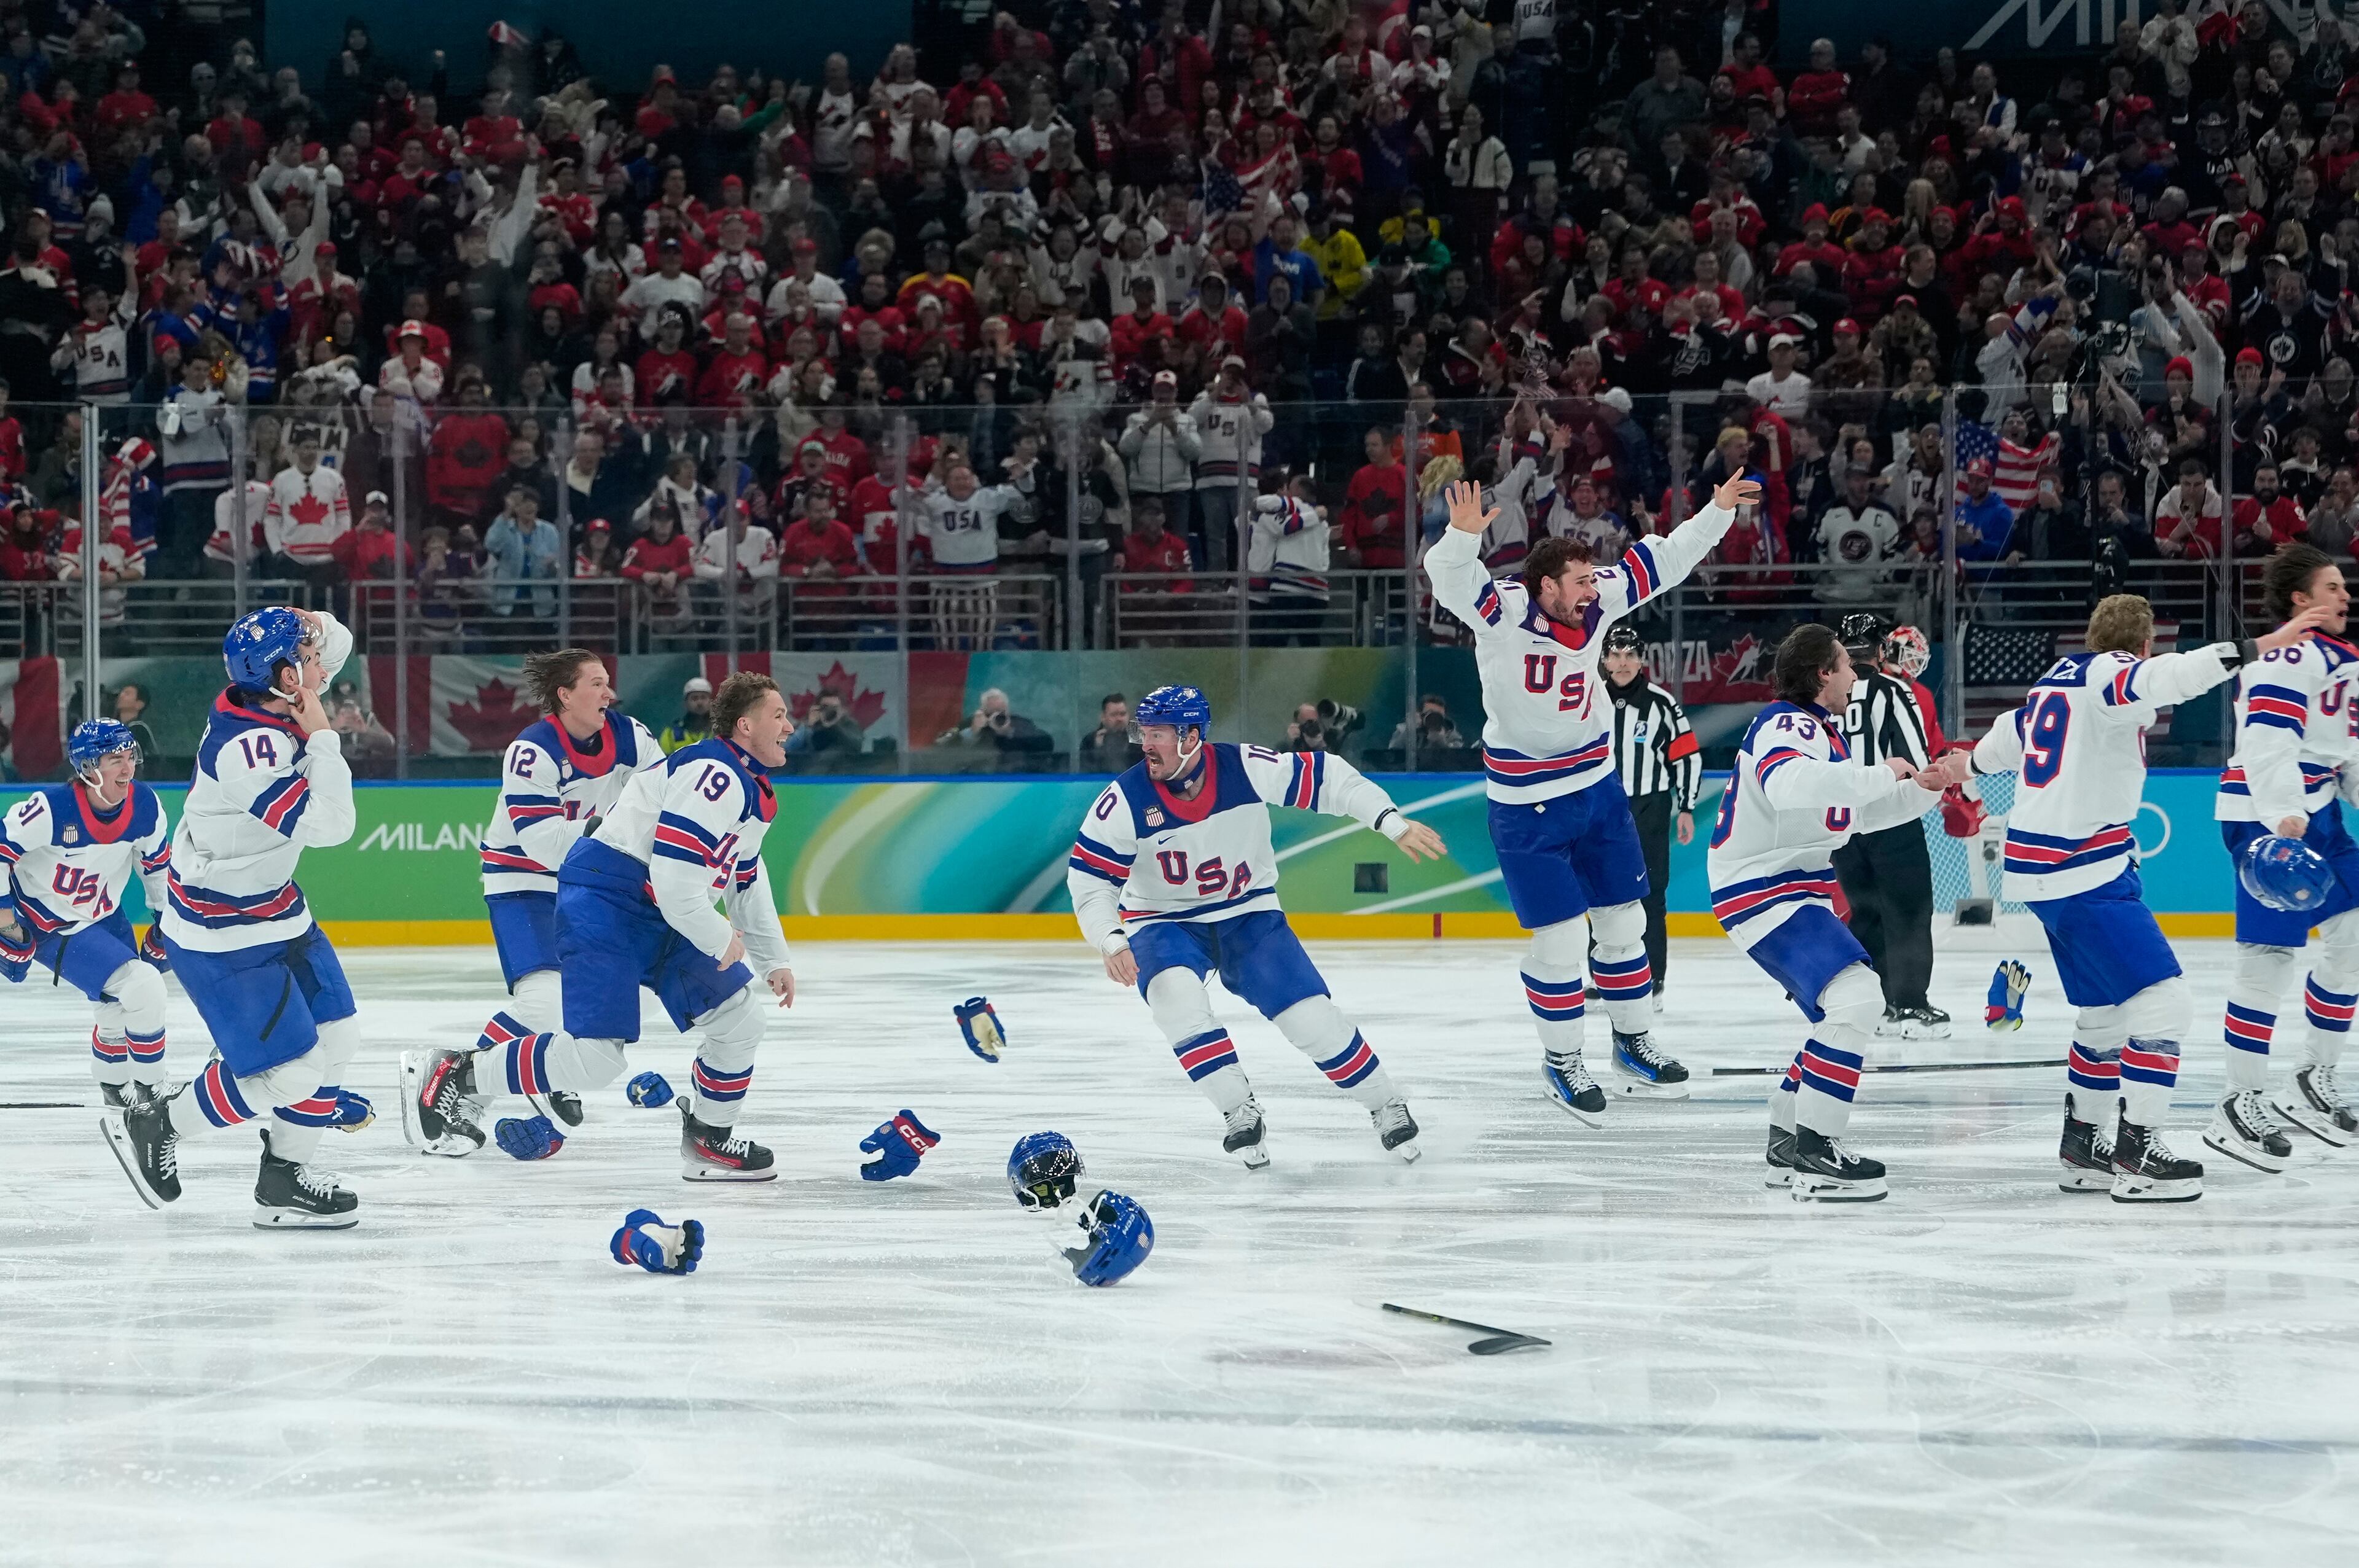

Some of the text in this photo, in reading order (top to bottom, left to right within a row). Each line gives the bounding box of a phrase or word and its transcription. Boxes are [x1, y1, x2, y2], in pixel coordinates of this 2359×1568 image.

[1524, 2, 1552, 19] USA
[76, 346, 121, 368] USA
[1208, 415, 1235, 437] US
[944, 510, 982, 532] USA
[264, 646, 283, 662] CCM
[1776, 715, 1817, 741] 43
[2023, 689, 2071, 789] 9
[238, 735, 277, 770] 14
[511, 745, 537, 779] 12
[694, 763, 731, 802] 19
[1096, 789, 1117, 821] 0
[357, 823, 492, 852] MILAN
[1156, 851, 1253, 900] USA
[52, 863, 114, 919] USA
[1122, 1214, 1135, 1236] CCM
